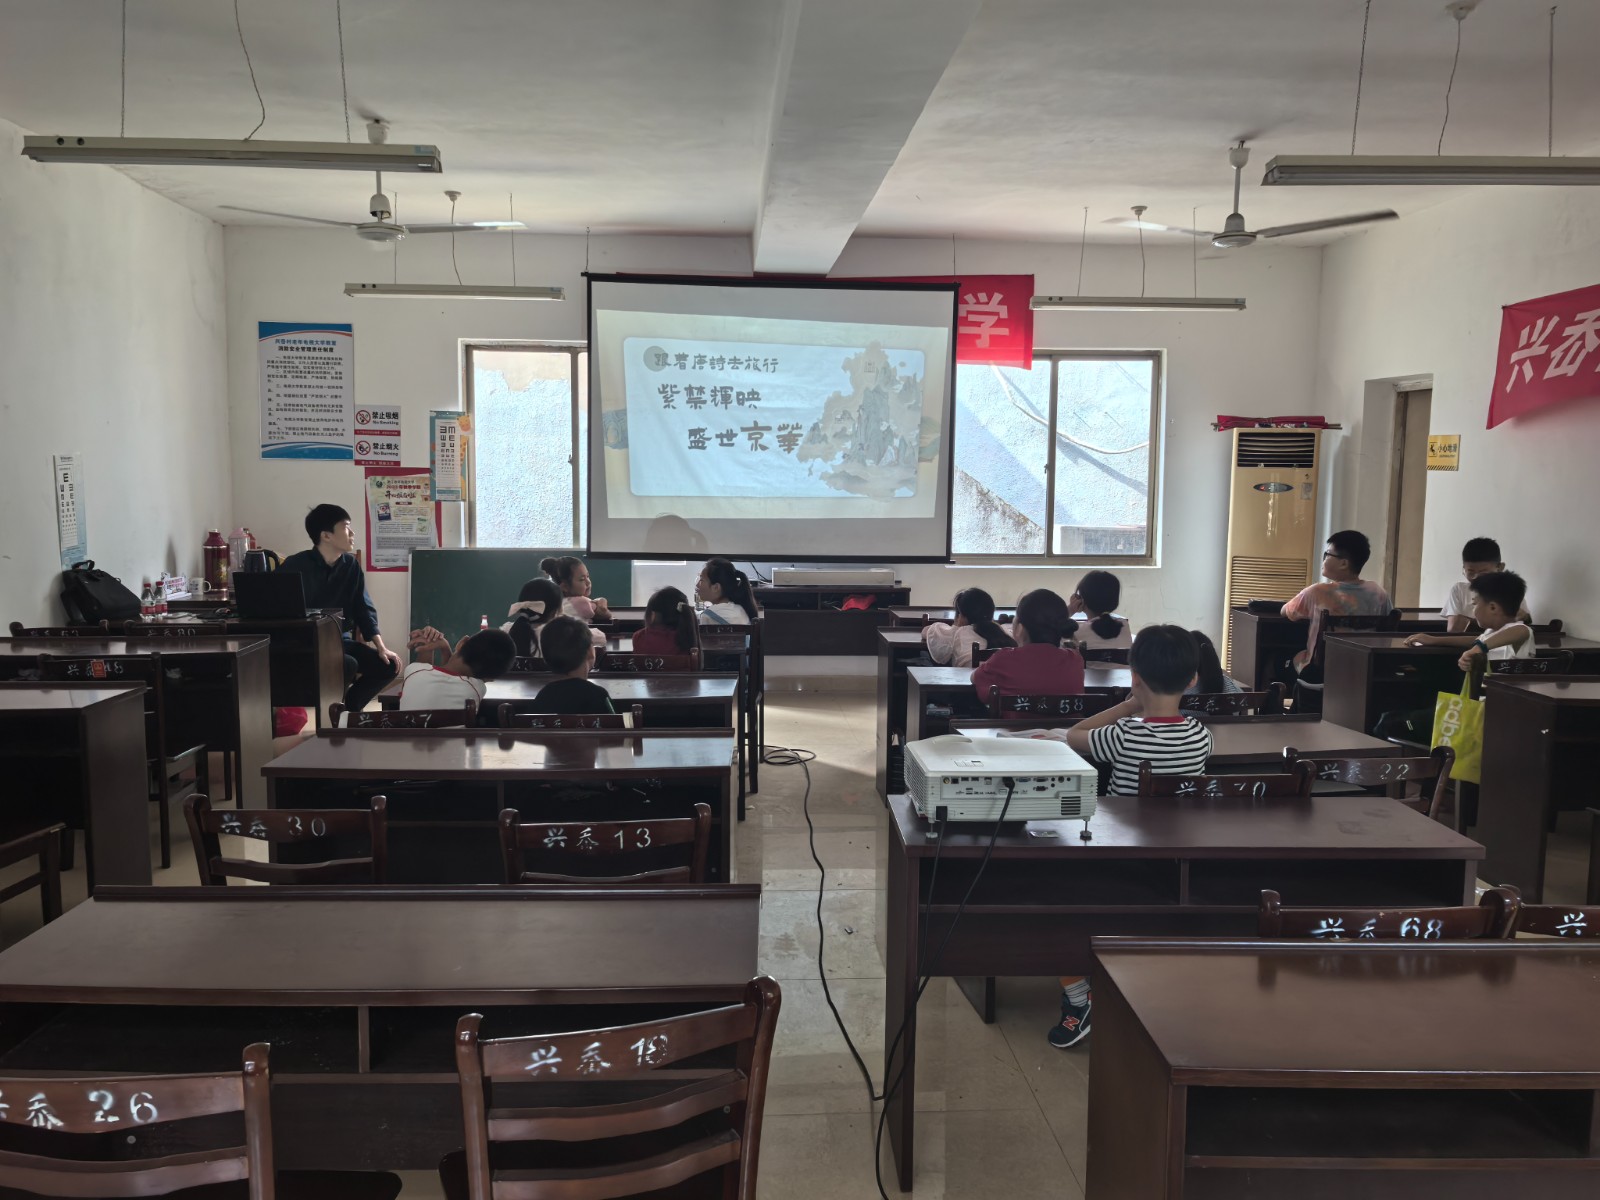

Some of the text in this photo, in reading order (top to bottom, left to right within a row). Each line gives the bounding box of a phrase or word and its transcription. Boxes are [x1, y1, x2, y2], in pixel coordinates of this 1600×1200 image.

[958, 293, 1010, 349] 学
[1054, 697, 1084, 712] 58
[613, 827, 652, 849] 13
[1400, 917, 1444, 938] 68
[87, 1090, 158, 1124] 26
